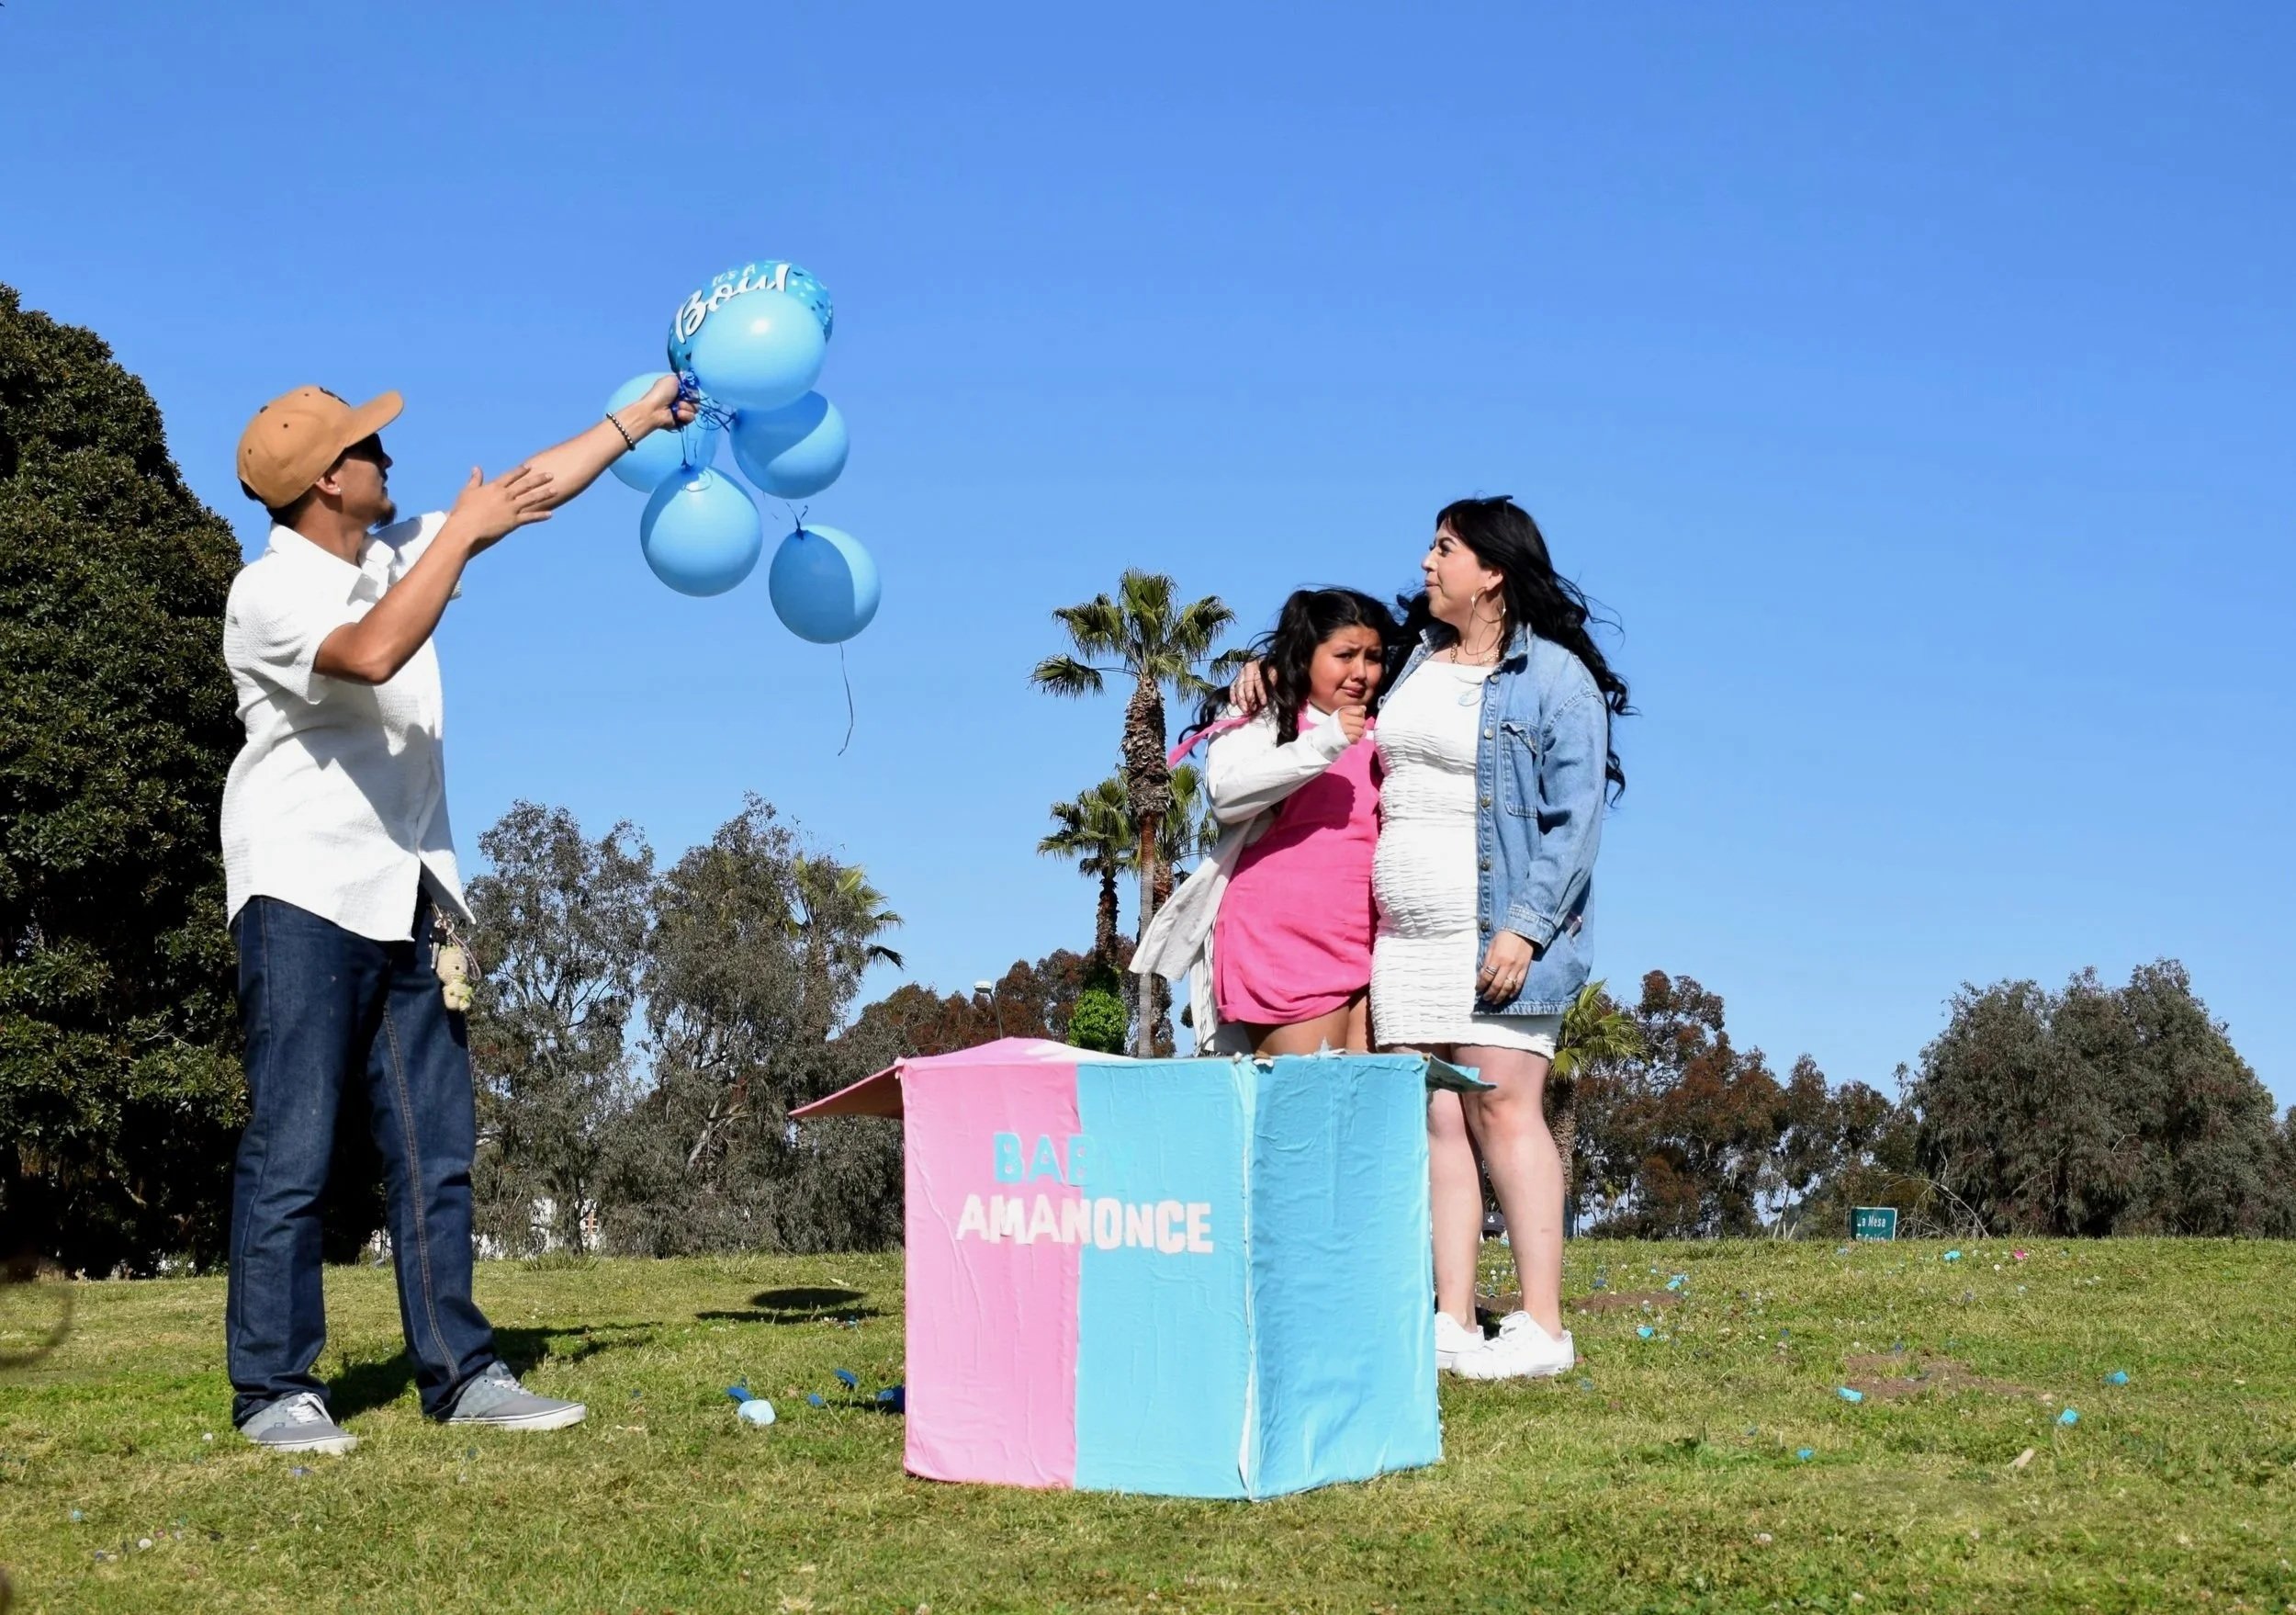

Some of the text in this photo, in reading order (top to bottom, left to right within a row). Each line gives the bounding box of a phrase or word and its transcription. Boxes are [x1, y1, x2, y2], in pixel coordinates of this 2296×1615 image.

[956, 1193, 1213, 1254] AMANONCE
[1856, 1214, 1886, 1228] La Mesa
